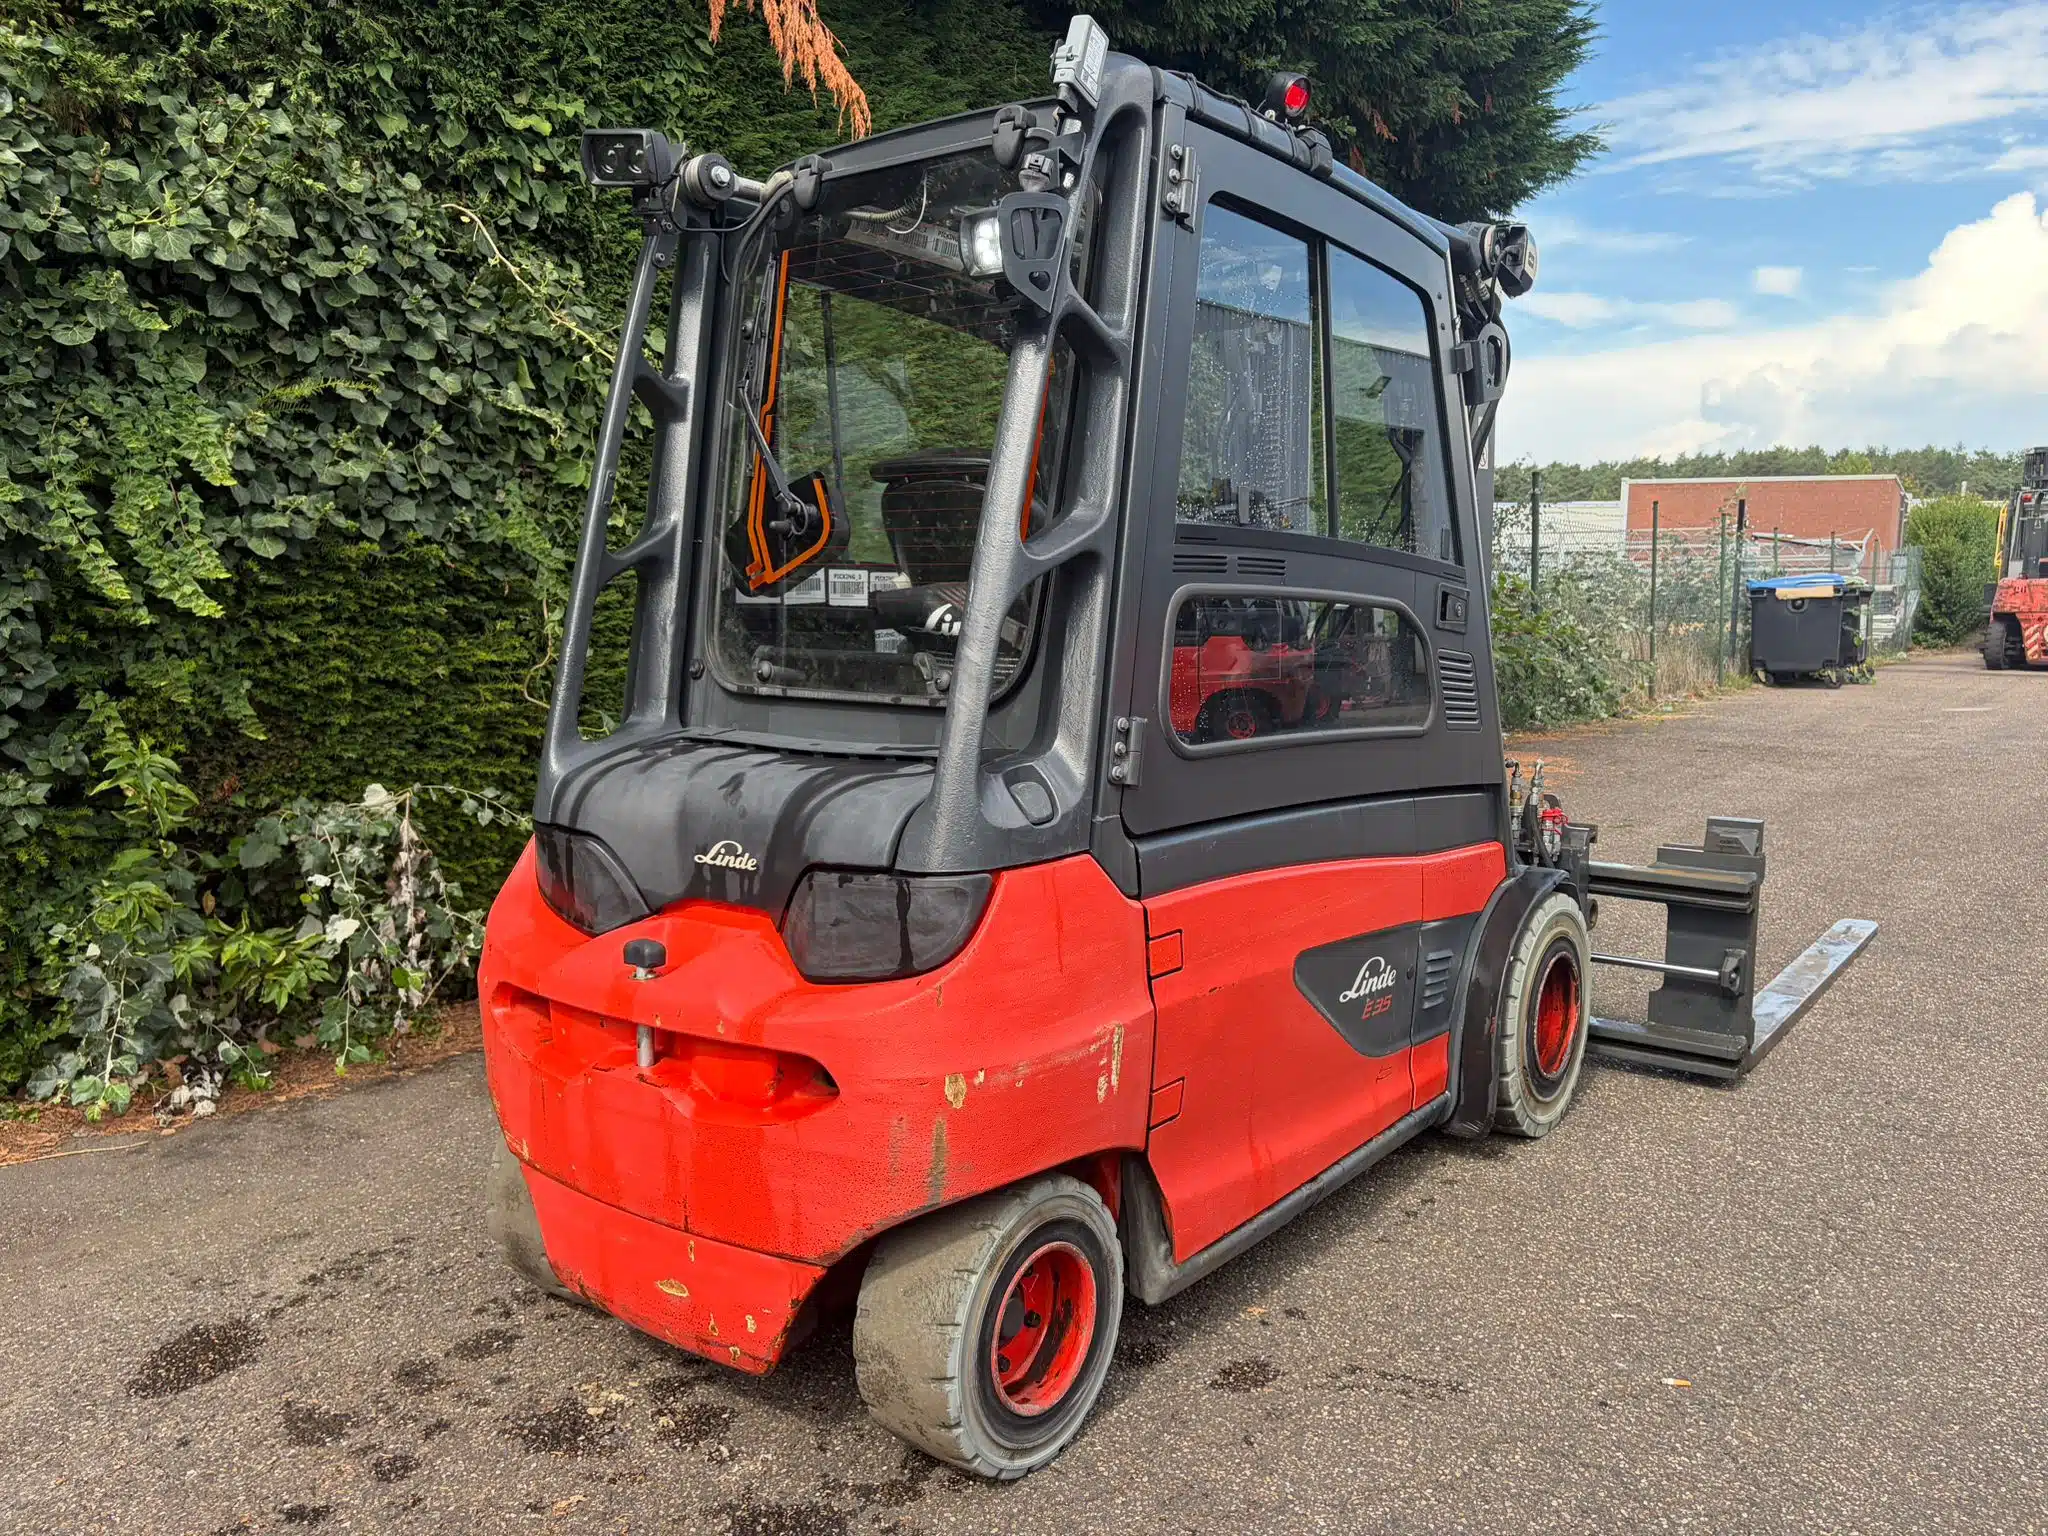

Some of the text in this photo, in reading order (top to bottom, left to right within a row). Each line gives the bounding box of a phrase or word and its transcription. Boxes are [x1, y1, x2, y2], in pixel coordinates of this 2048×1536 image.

[694, 840, 757, 871] Linde
[1339, 956, 1397, 1003] Linde
[1363, 995, 1393, 1020] E35
